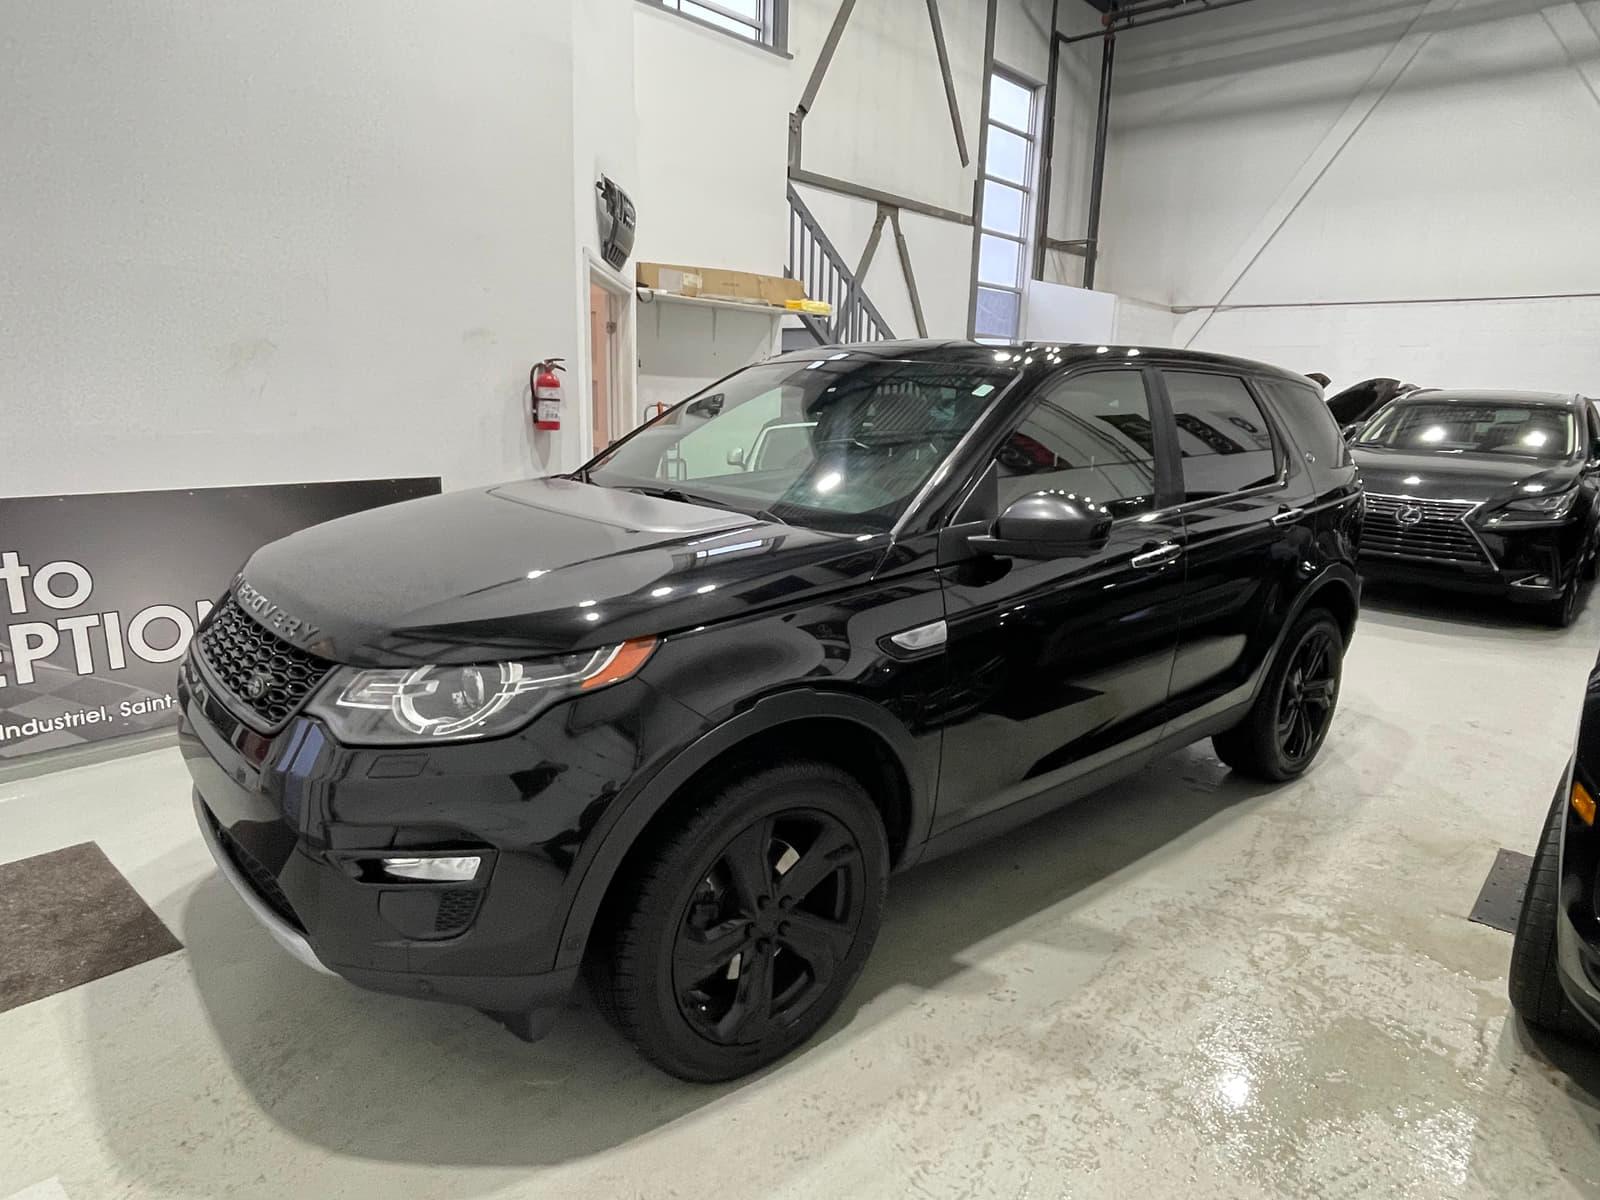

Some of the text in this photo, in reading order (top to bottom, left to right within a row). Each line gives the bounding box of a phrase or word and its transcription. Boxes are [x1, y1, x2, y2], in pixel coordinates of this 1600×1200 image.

[0, 599, 214, 688] PTIO
[0, 693, 178, 739] Industriel, Saint-
